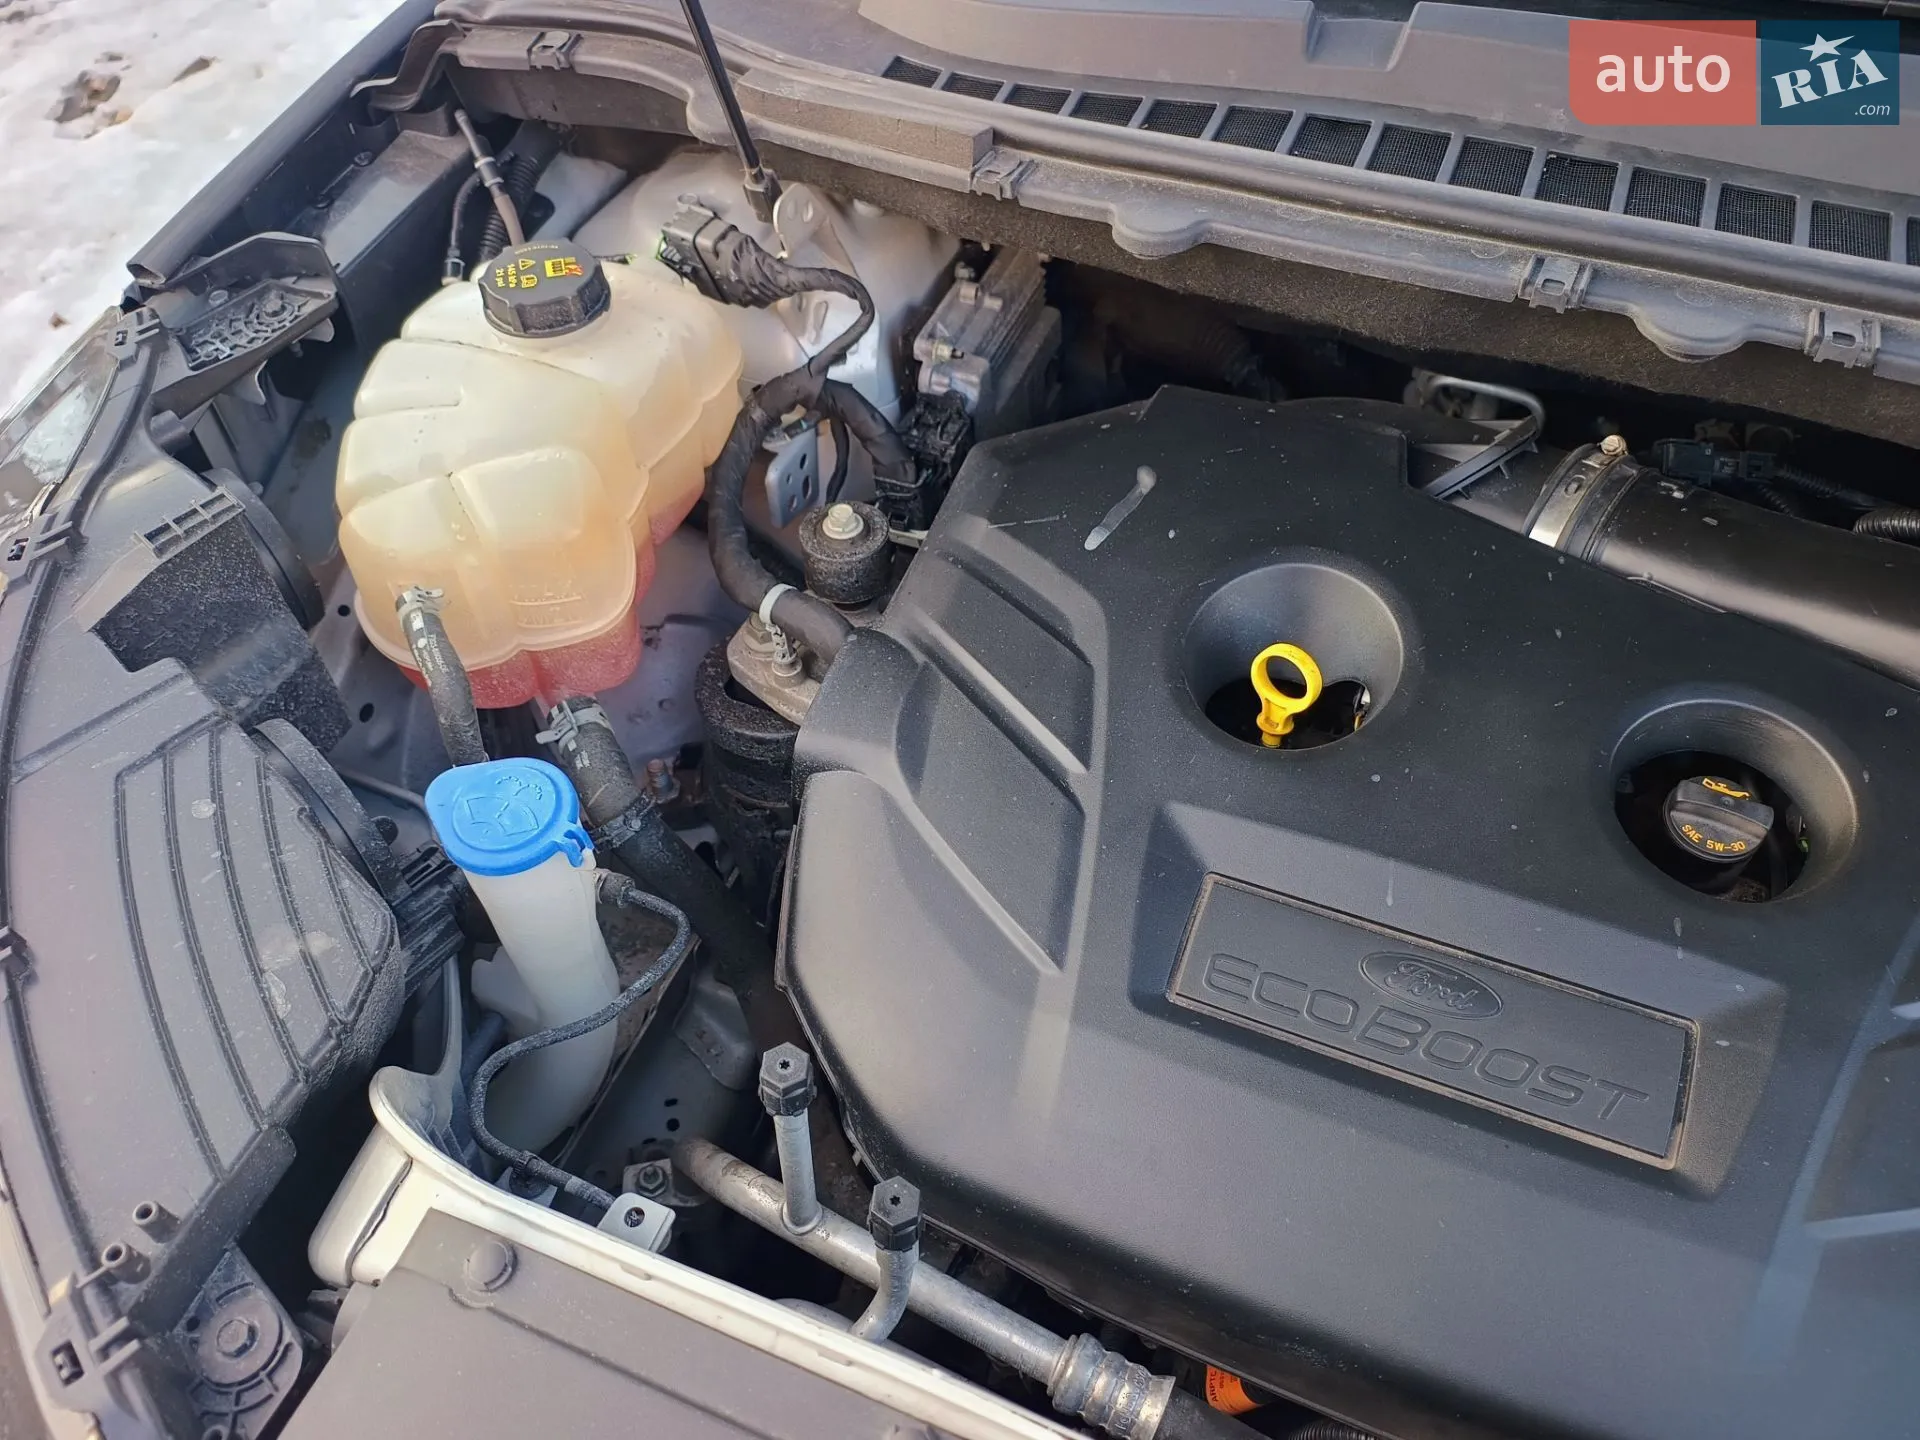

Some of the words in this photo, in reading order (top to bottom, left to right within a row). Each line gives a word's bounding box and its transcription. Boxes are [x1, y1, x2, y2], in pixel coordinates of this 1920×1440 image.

[1682, 824, 1703, 843] SAE
[1706, 840, 1746, 852] 5W-30
[1384, 960, 1479, 1010] Ford
